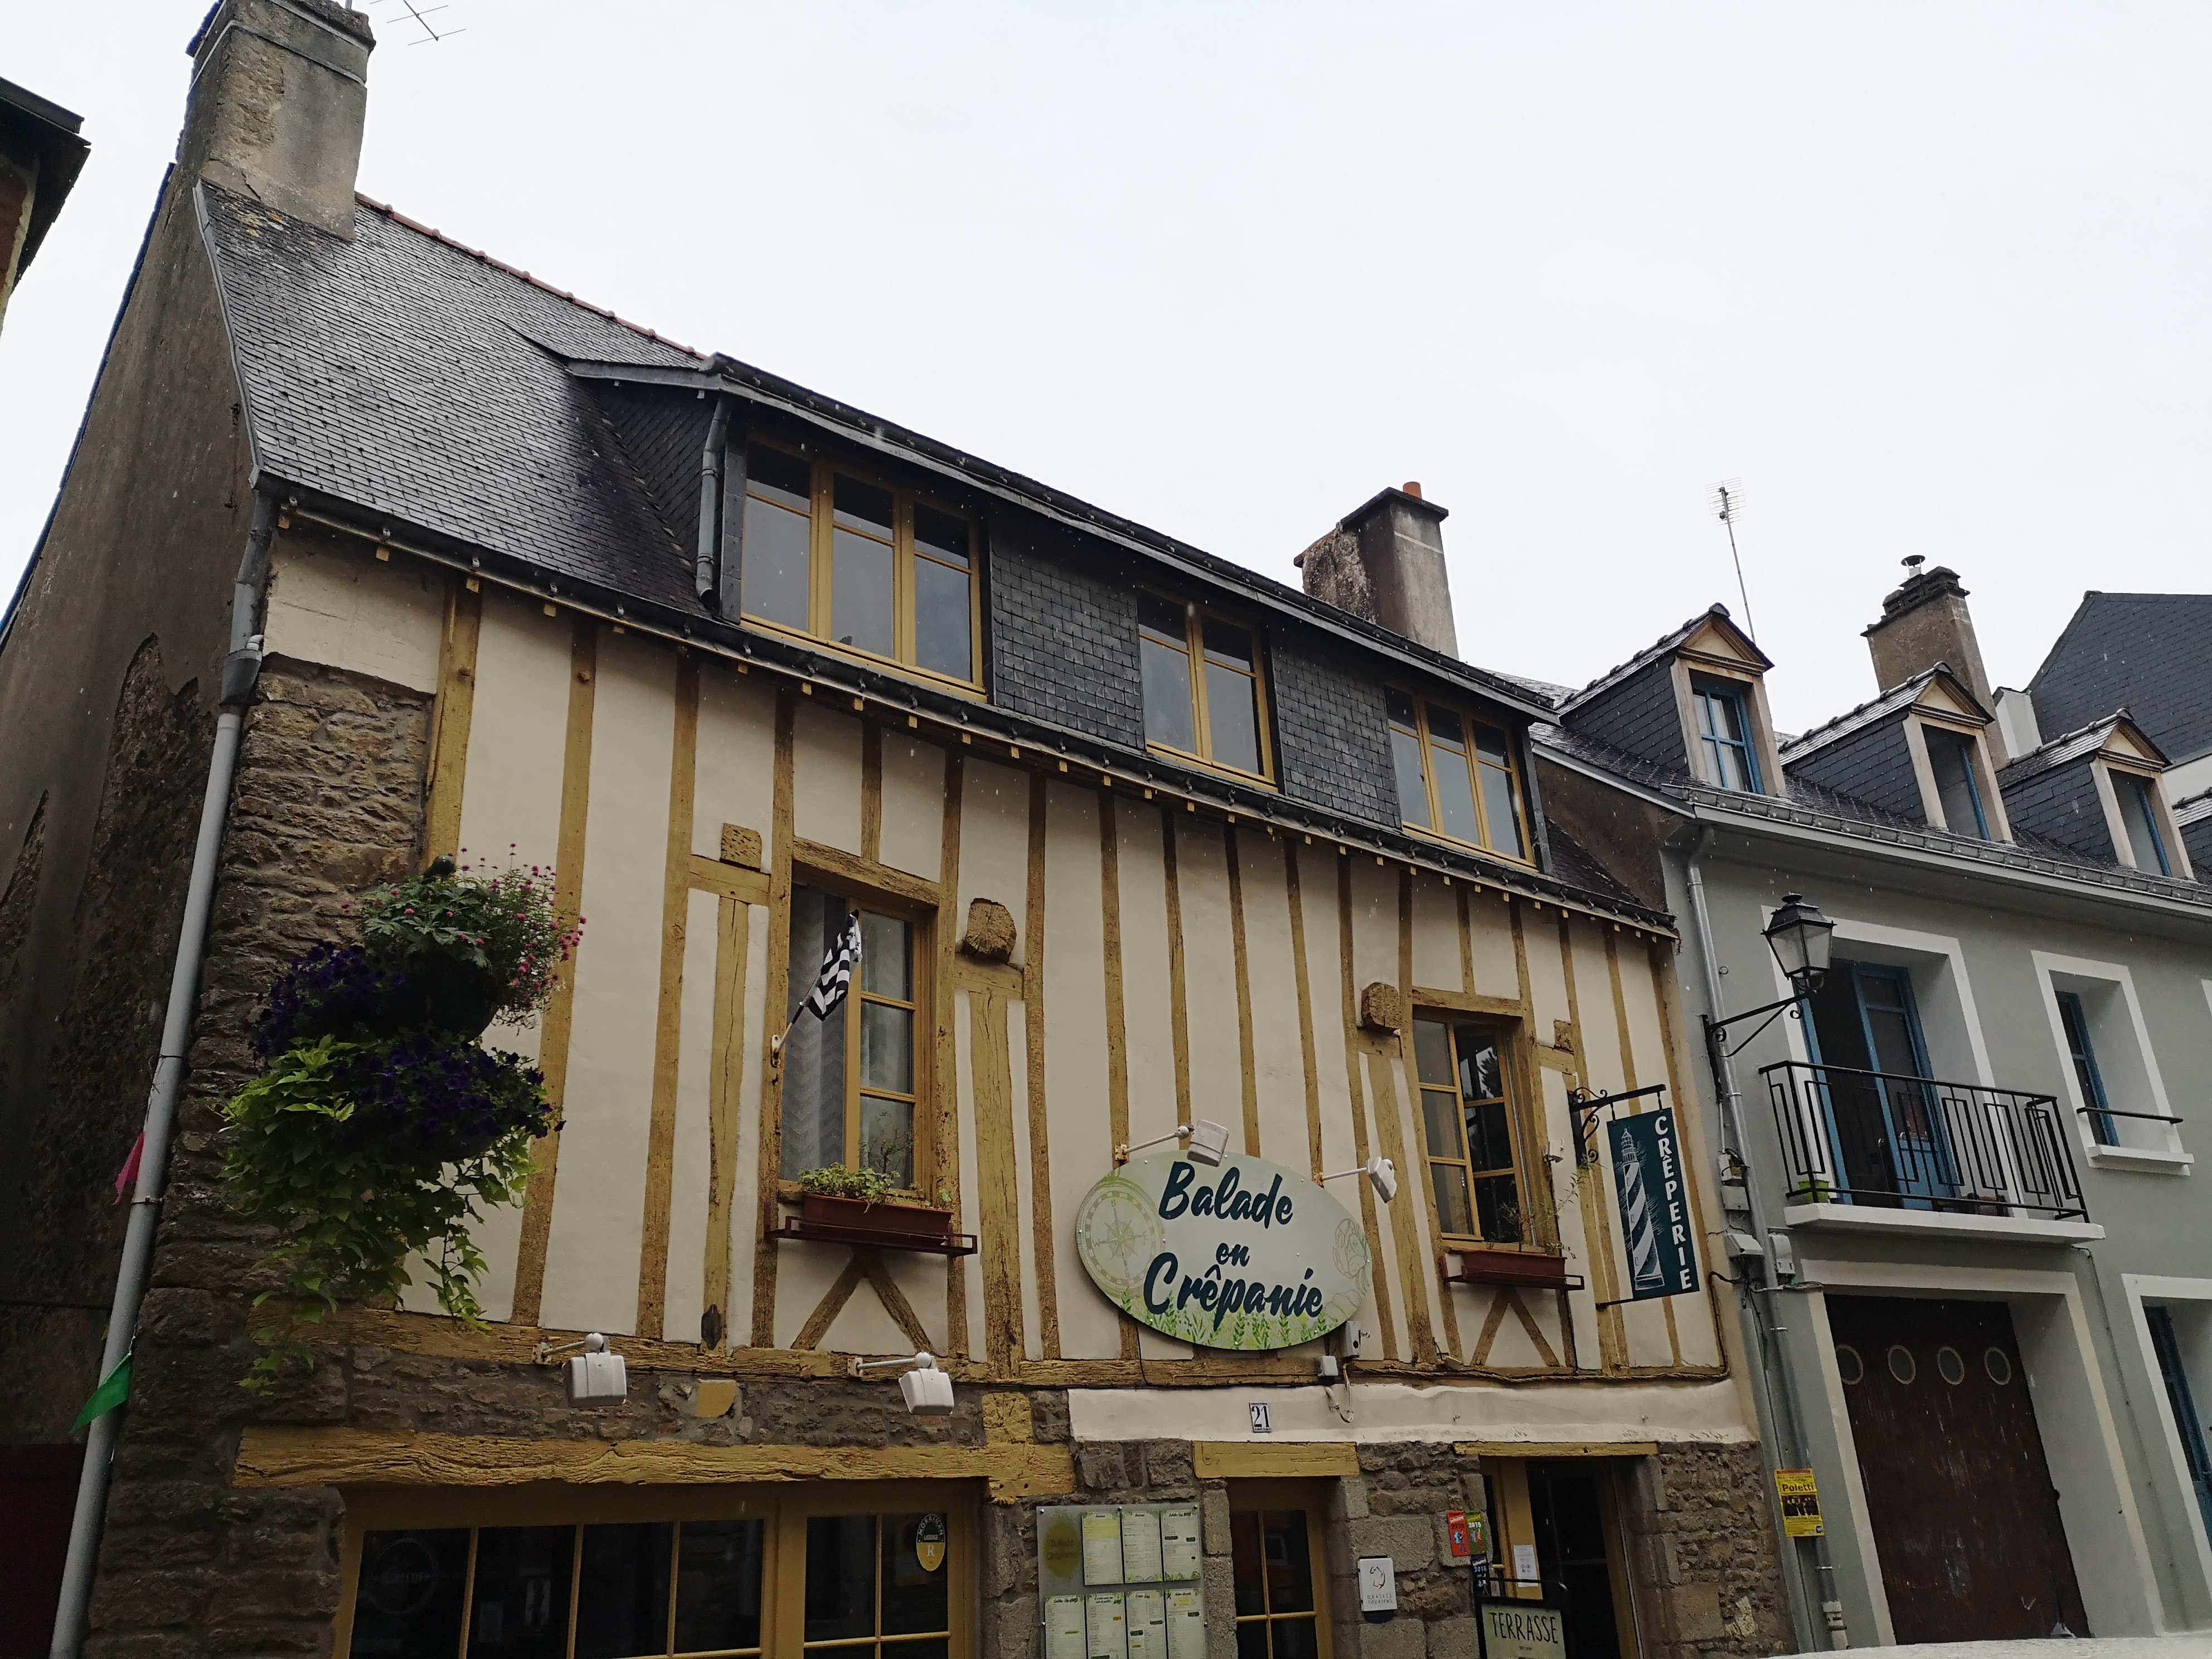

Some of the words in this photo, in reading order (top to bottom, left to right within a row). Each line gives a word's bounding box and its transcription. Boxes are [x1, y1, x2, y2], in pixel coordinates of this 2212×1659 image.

[1158, 1161, 1293, 1229] Balade
[1655, 1115, 1692, 1290] CRÊPERIE
[1216, 1243, 1250, 1267] en
[1143, 1252, 1323, 1332] Crêpanie
[1251, 1405, 1270, 1427] 21
[1782, 1482, 1814, 1492] Poletti
[918, 1515, 943, 1536] MORBIHAN
[1489, 1612, 1558, 1644] TERRASSE
